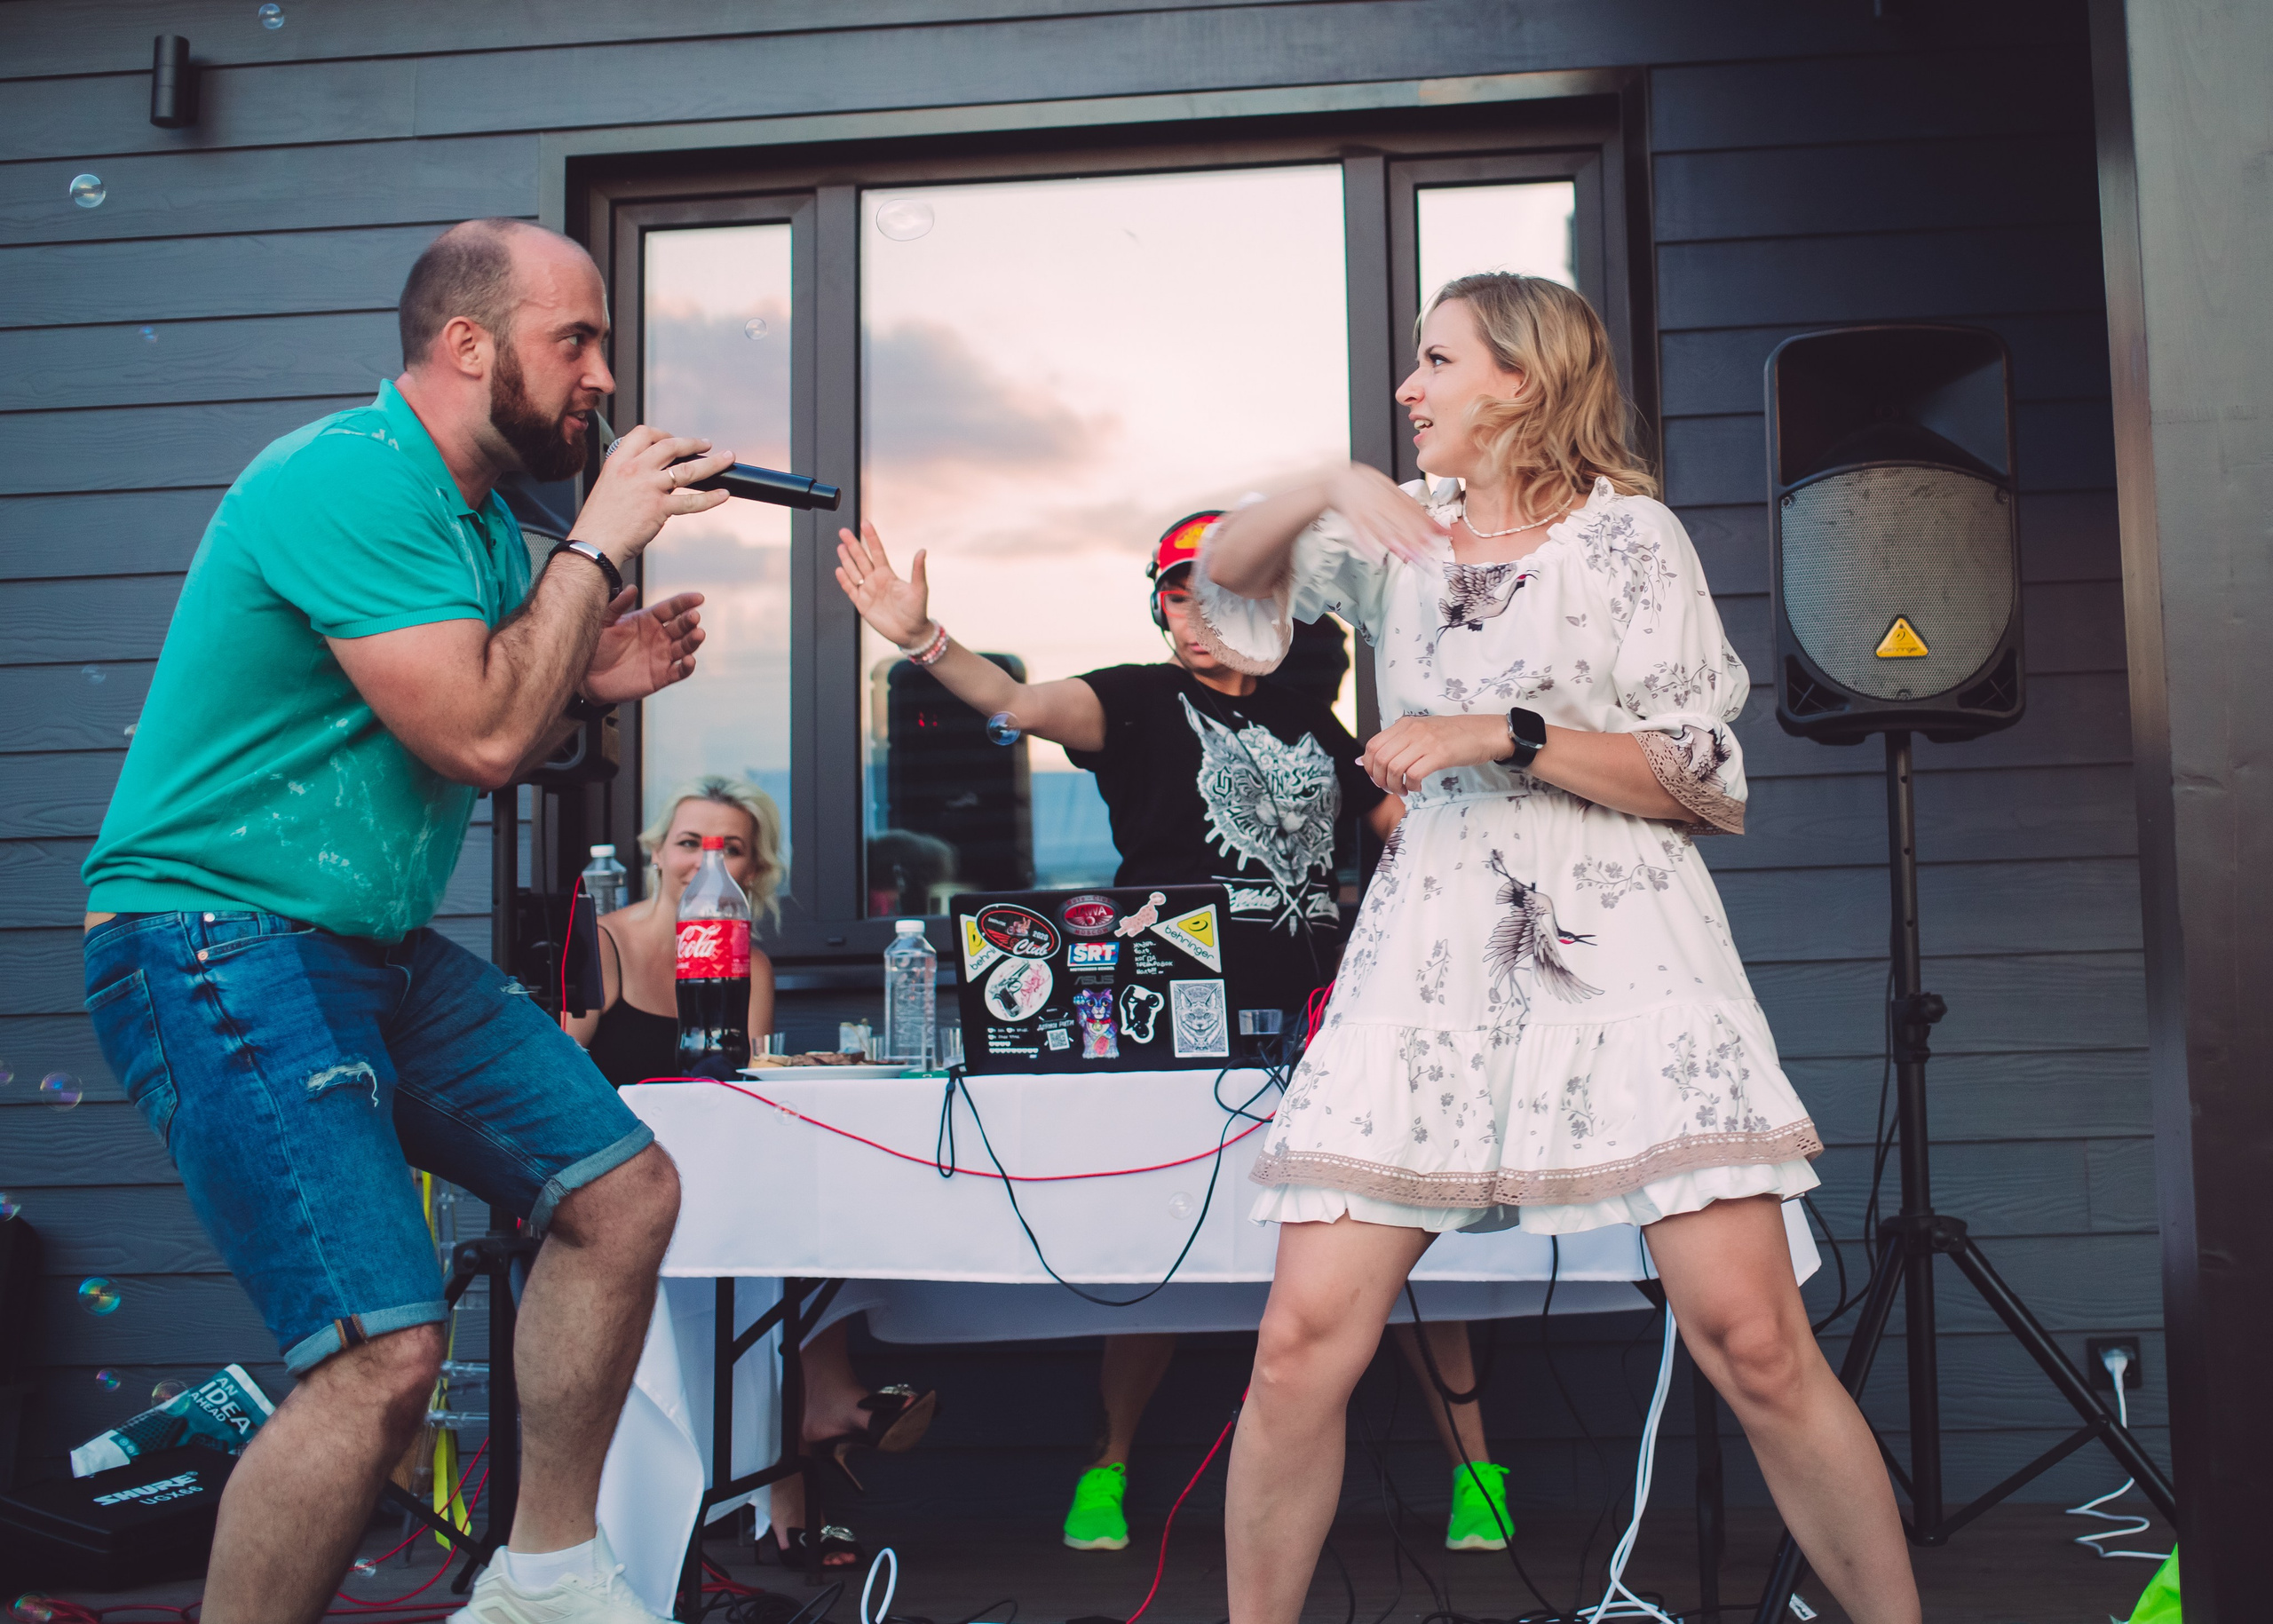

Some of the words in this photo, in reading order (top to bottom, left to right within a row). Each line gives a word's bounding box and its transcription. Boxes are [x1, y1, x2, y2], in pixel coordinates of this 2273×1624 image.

[1033, 930, 1049, 941] 2020
[1074, 927, 1109, 936] MOSCOW
[1012, 939, 1050, 956] Club
[1164, 925, 1215, 959] behringer
[1074, 975, 1114, 986] ASUS
[216, 1377, 239, 1397] AN
[188, 1391, 226, 1422] AHEAD
[198, 1381, 251, 1435] IDEA
[92, 1474, 197, 1506] SHURE
